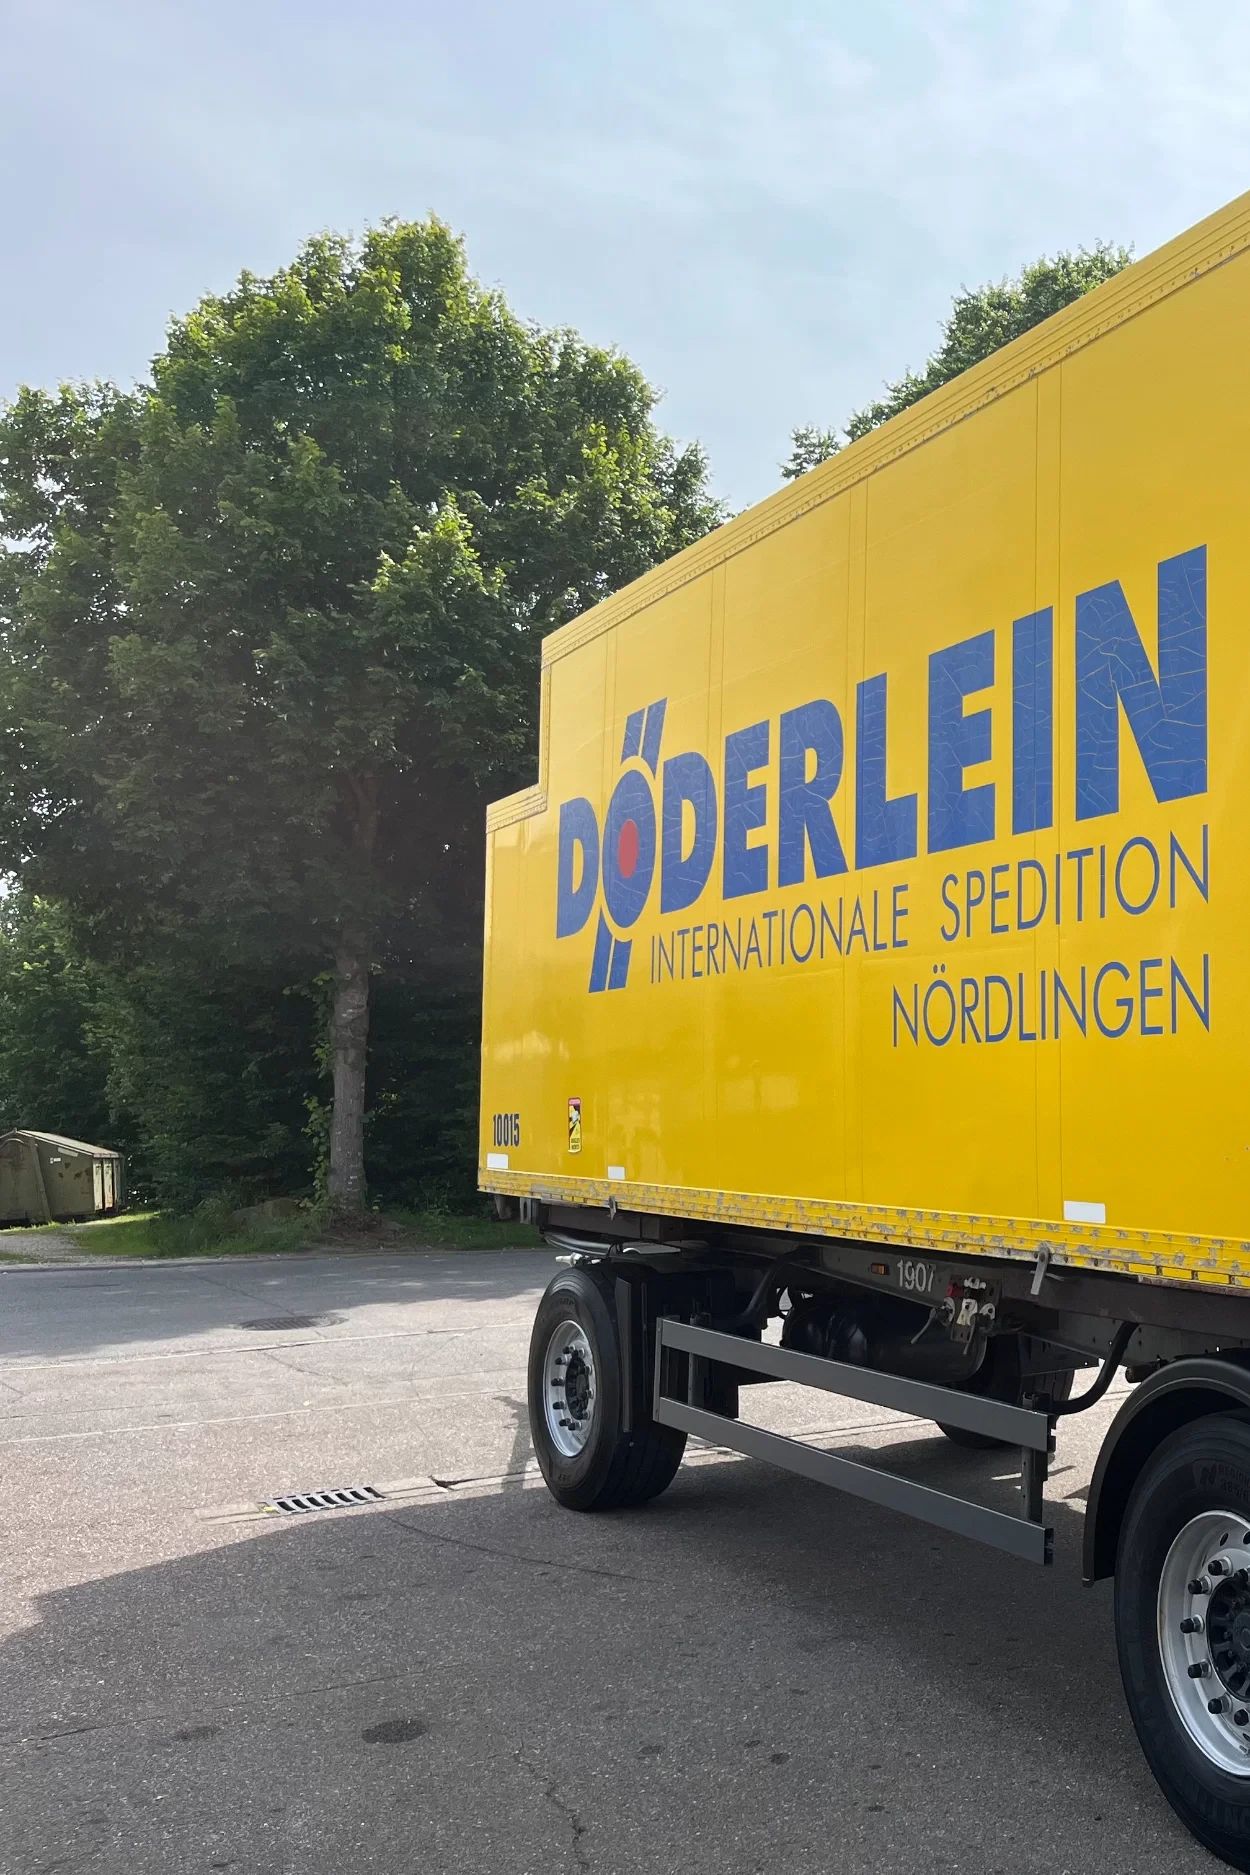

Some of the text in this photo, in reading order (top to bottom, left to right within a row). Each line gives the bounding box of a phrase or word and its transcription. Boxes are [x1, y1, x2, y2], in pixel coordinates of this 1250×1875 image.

[556, 544, 1208, 993] DÖDERLEIN
[650, 824, 1209, 984] INTERNATIONALE SPEDITION
[892, 954, 1210, 1047] NÖRDLINGEN
[493, 1113, 520, 1147] 10015
[897, 1259, 936, 1293] 1907
